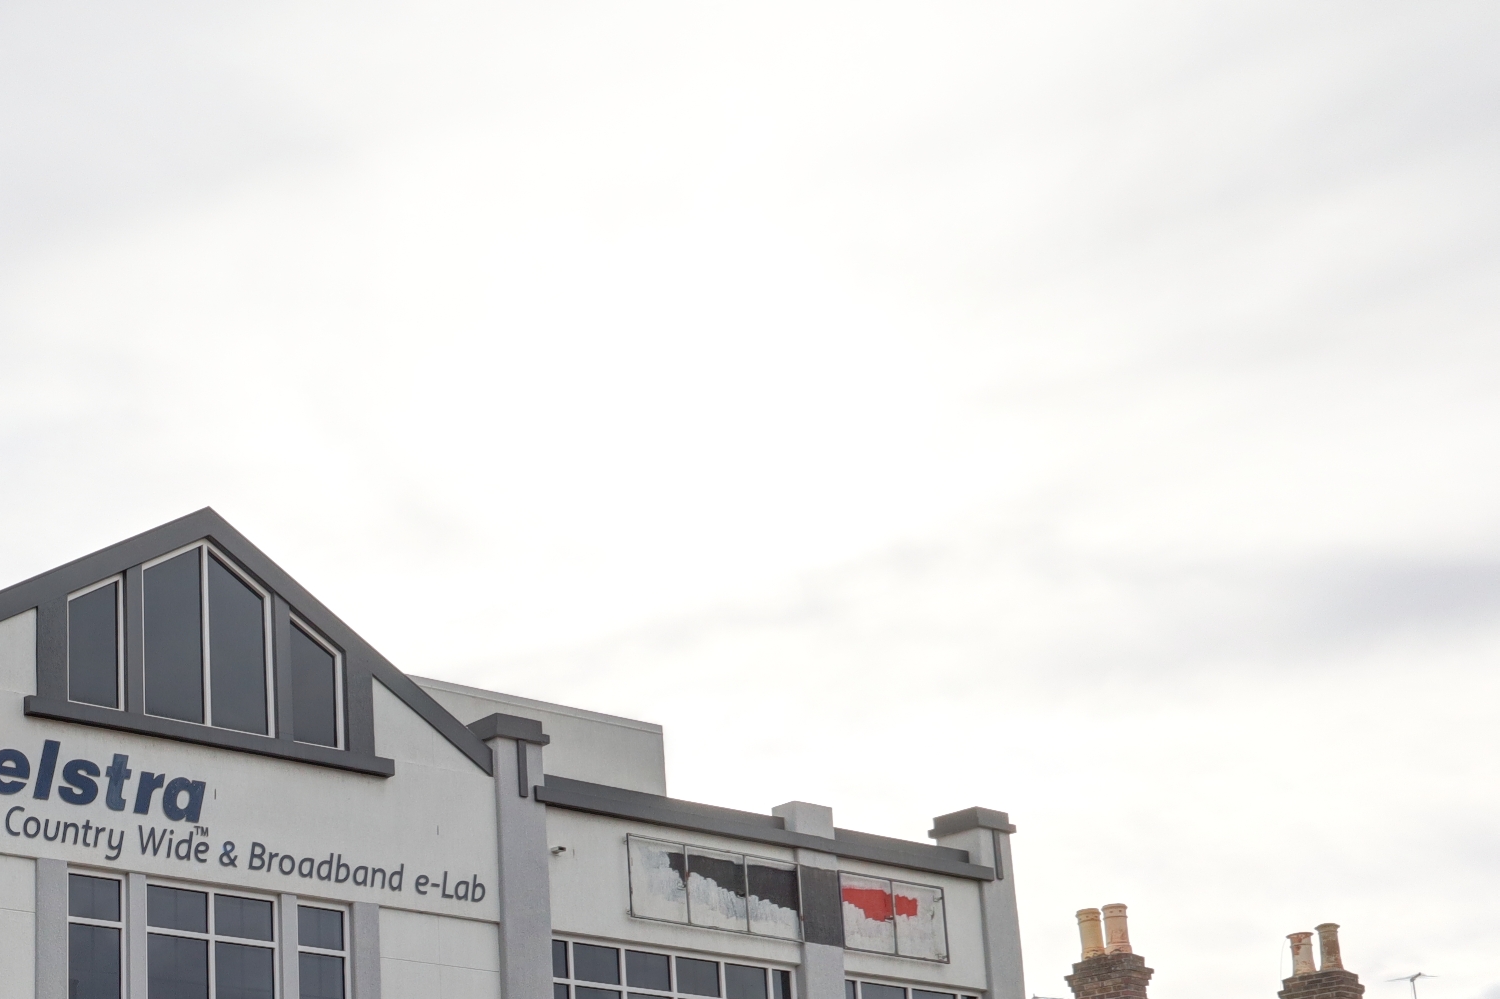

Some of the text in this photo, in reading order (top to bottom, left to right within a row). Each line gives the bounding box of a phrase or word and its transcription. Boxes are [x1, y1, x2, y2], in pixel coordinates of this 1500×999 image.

[5, 805, 486, 903] Country Wide & Broadband e-Lab
